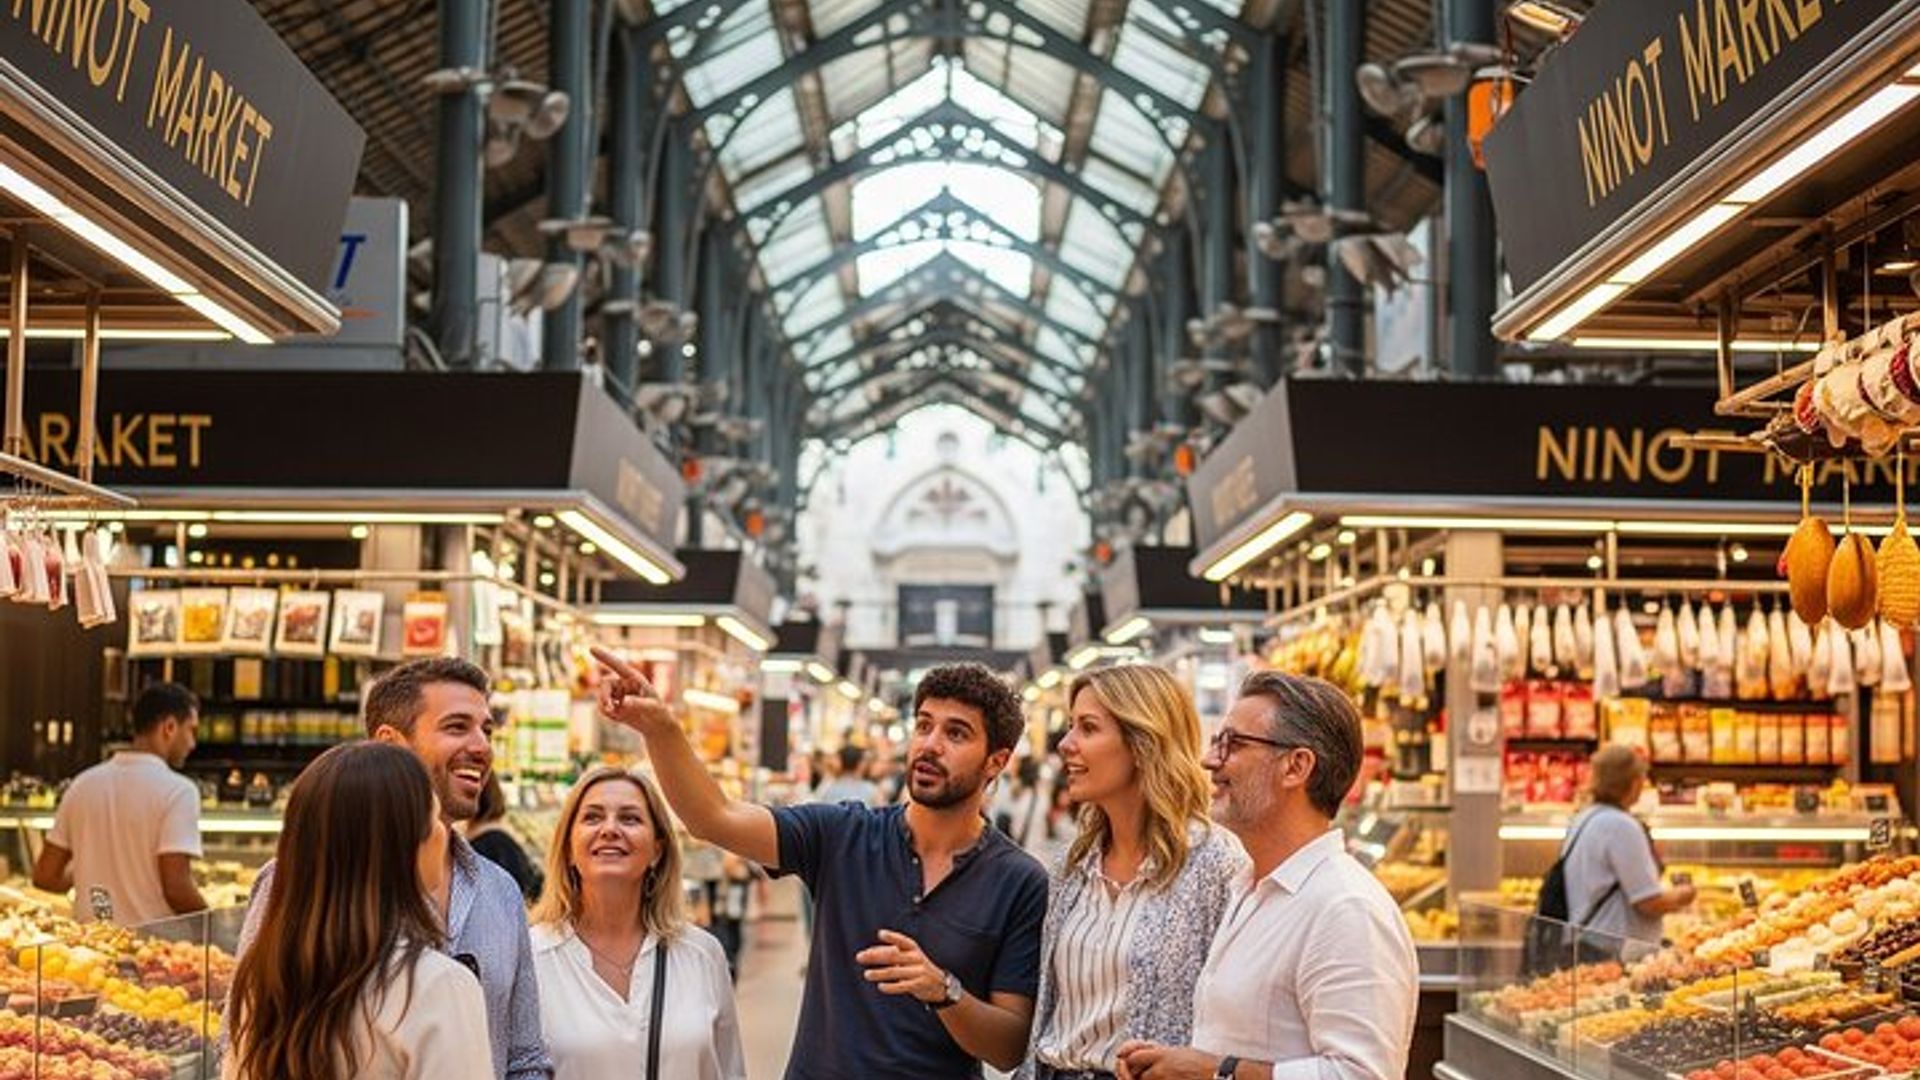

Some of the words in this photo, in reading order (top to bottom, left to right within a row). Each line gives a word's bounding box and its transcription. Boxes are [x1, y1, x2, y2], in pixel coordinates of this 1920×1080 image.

[12, 0, 150, 102] NOT
[147, 26, 273, 208] MARKET
[1578, 37, 1669, 208] NINOT
[1535, 425, 1736, 483] NINOT
